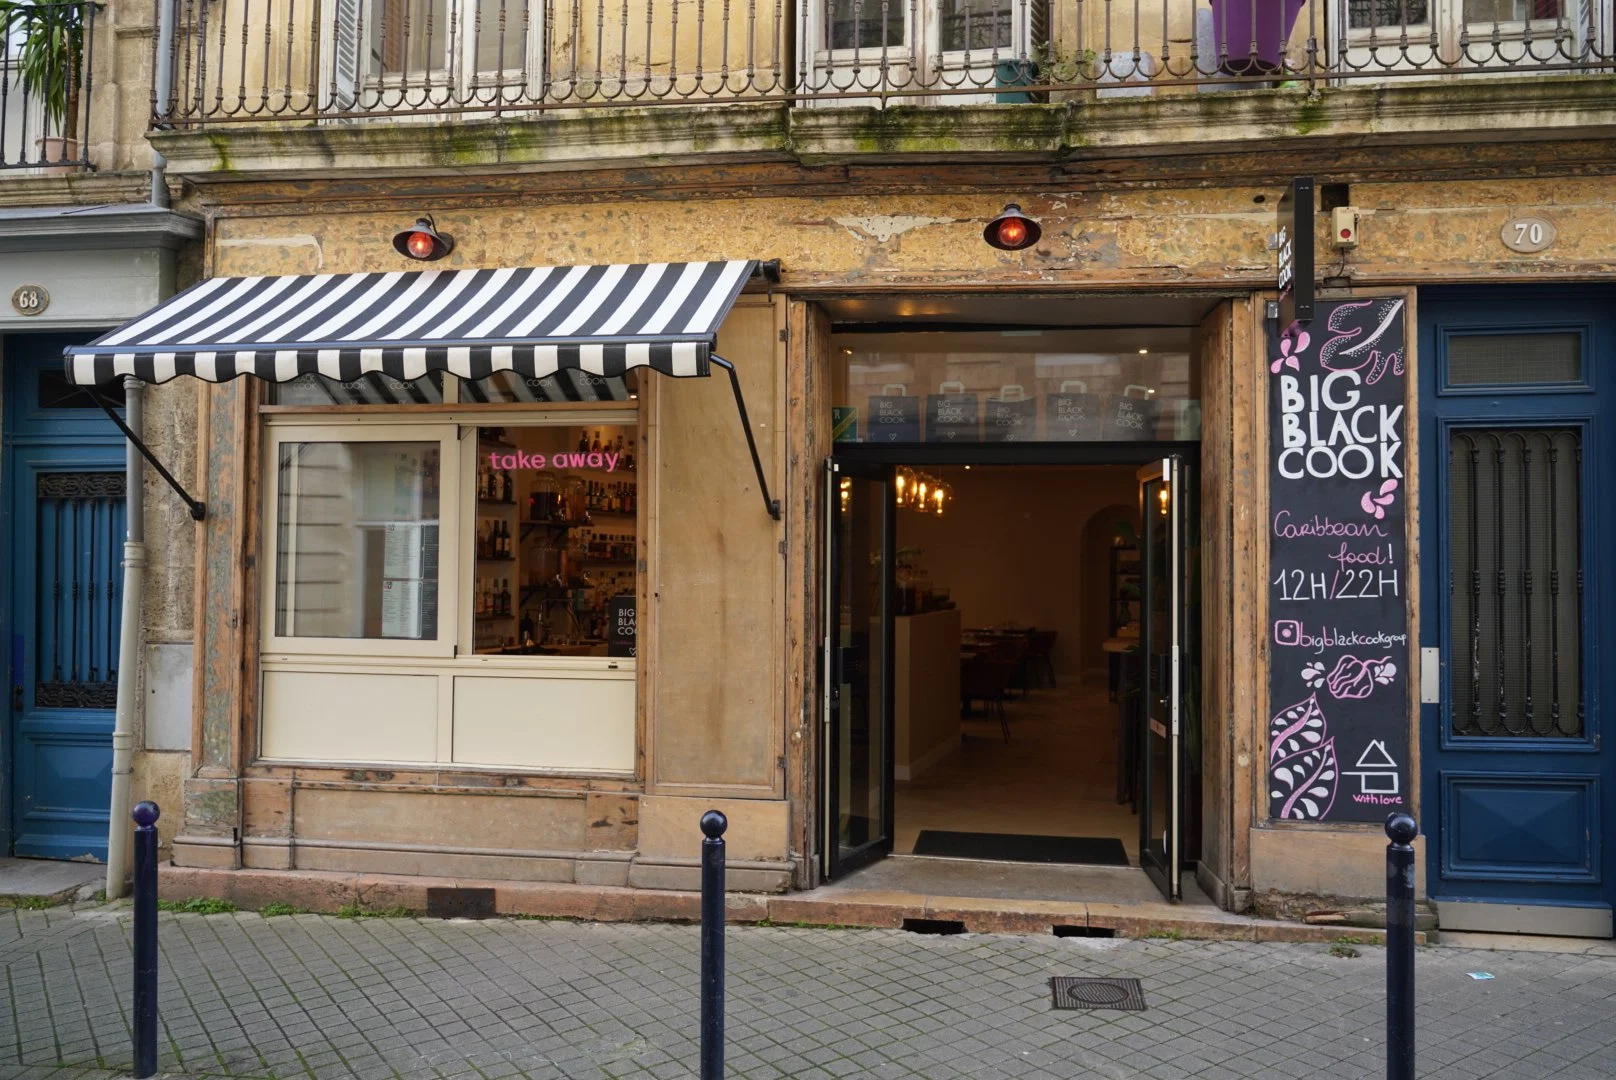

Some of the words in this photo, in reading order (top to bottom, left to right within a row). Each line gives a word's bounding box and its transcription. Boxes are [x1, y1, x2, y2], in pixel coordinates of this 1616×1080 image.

[1515, 223, 1543, 244] 70
[1278, 260, 1292, 289] COOK
[19, 290, 39, 308] 68
[1280, 369, 1361, 413] BIG
[1281, 404, 1404, 448] BLACK
[488, 450, 546, 470] take
[552, 451, 619, 472] away
[1278, 441, 1404, 479] COOK
[1274, 510, 1389, 538] Caribbean
[1273, 569, 1398, 600] 12H/22H
[618, 608, 635, 617] BIG
[1300, 621, 1407, 655] bigblackcookgroup
[1380, 795, 1403, 805] love
